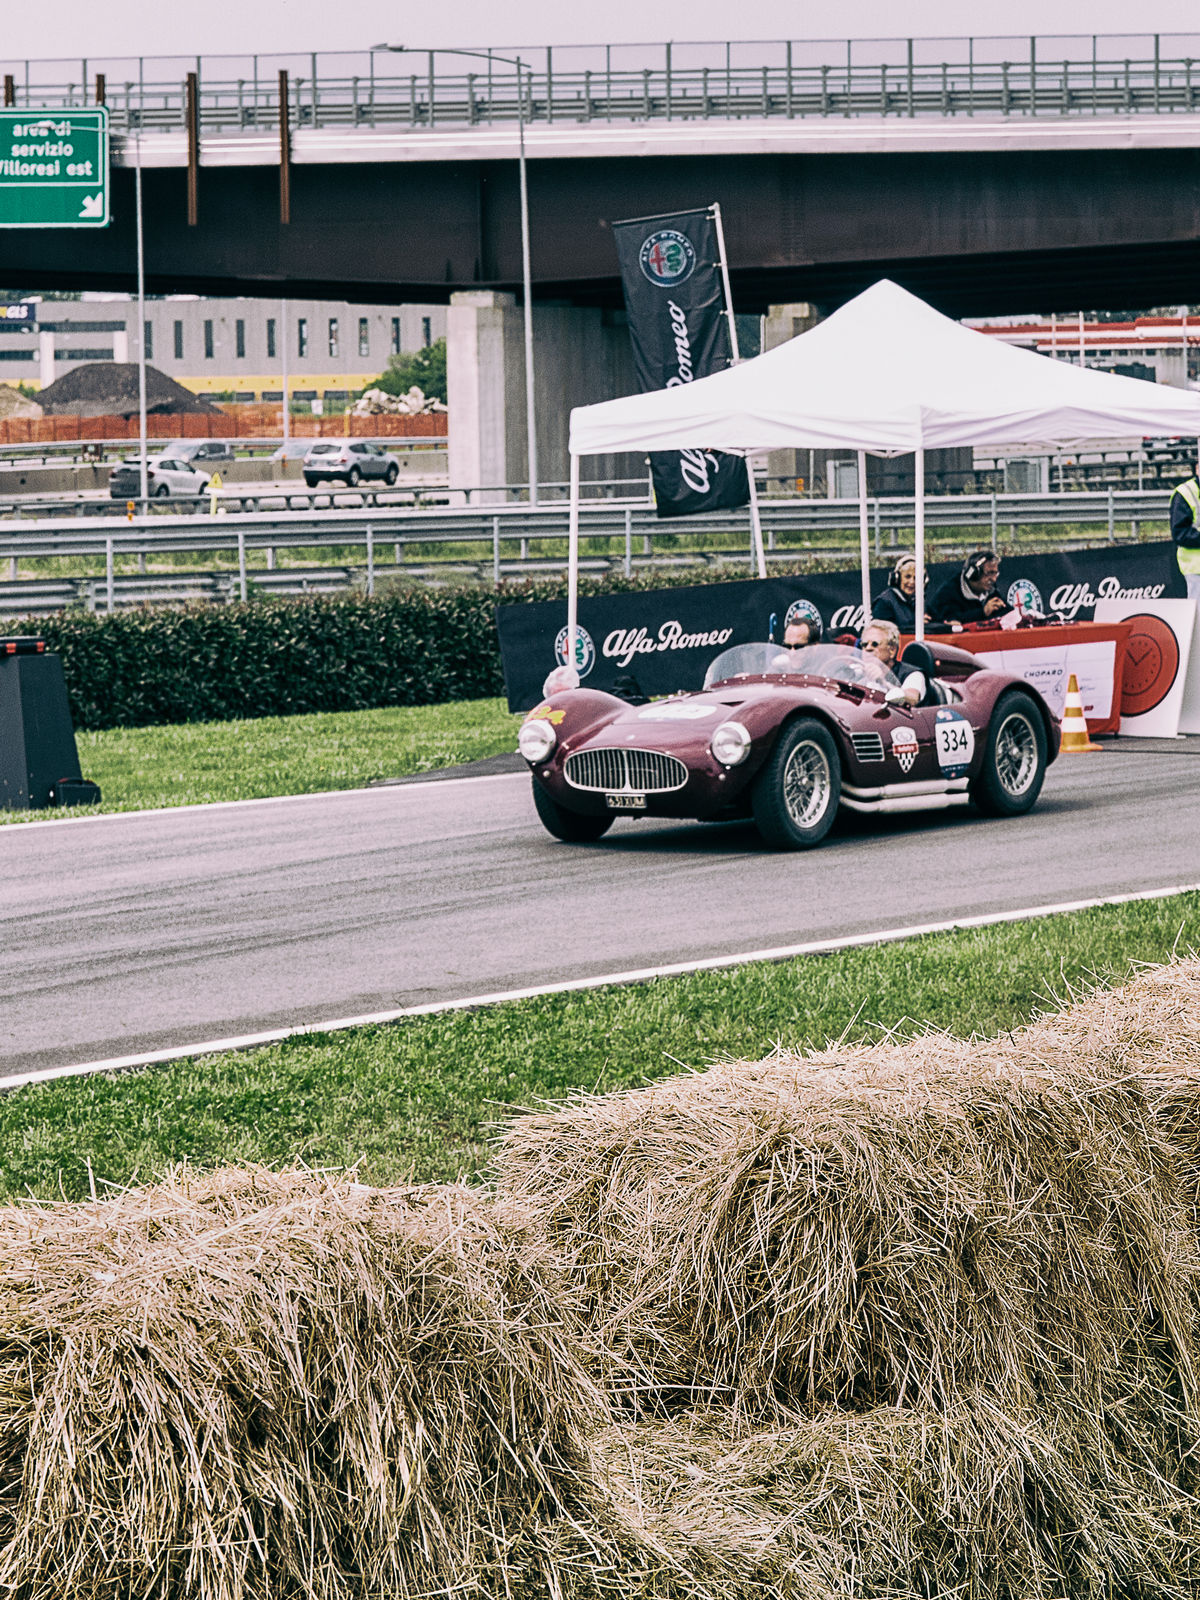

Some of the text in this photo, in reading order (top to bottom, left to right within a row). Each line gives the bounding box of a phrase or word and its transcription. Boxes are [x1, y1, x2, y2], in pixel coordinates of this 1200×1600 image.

[55, 120, 71, 136] di
[11, 141, 74, 157] servizio
[66, 160, 93, 176] est
[1050, 582, 1097, 620] Alfa
[602, 626, 658, 668] Alfa
[656, 620, 734, 652] Romeo
[942, 728, 968, 753] 334
